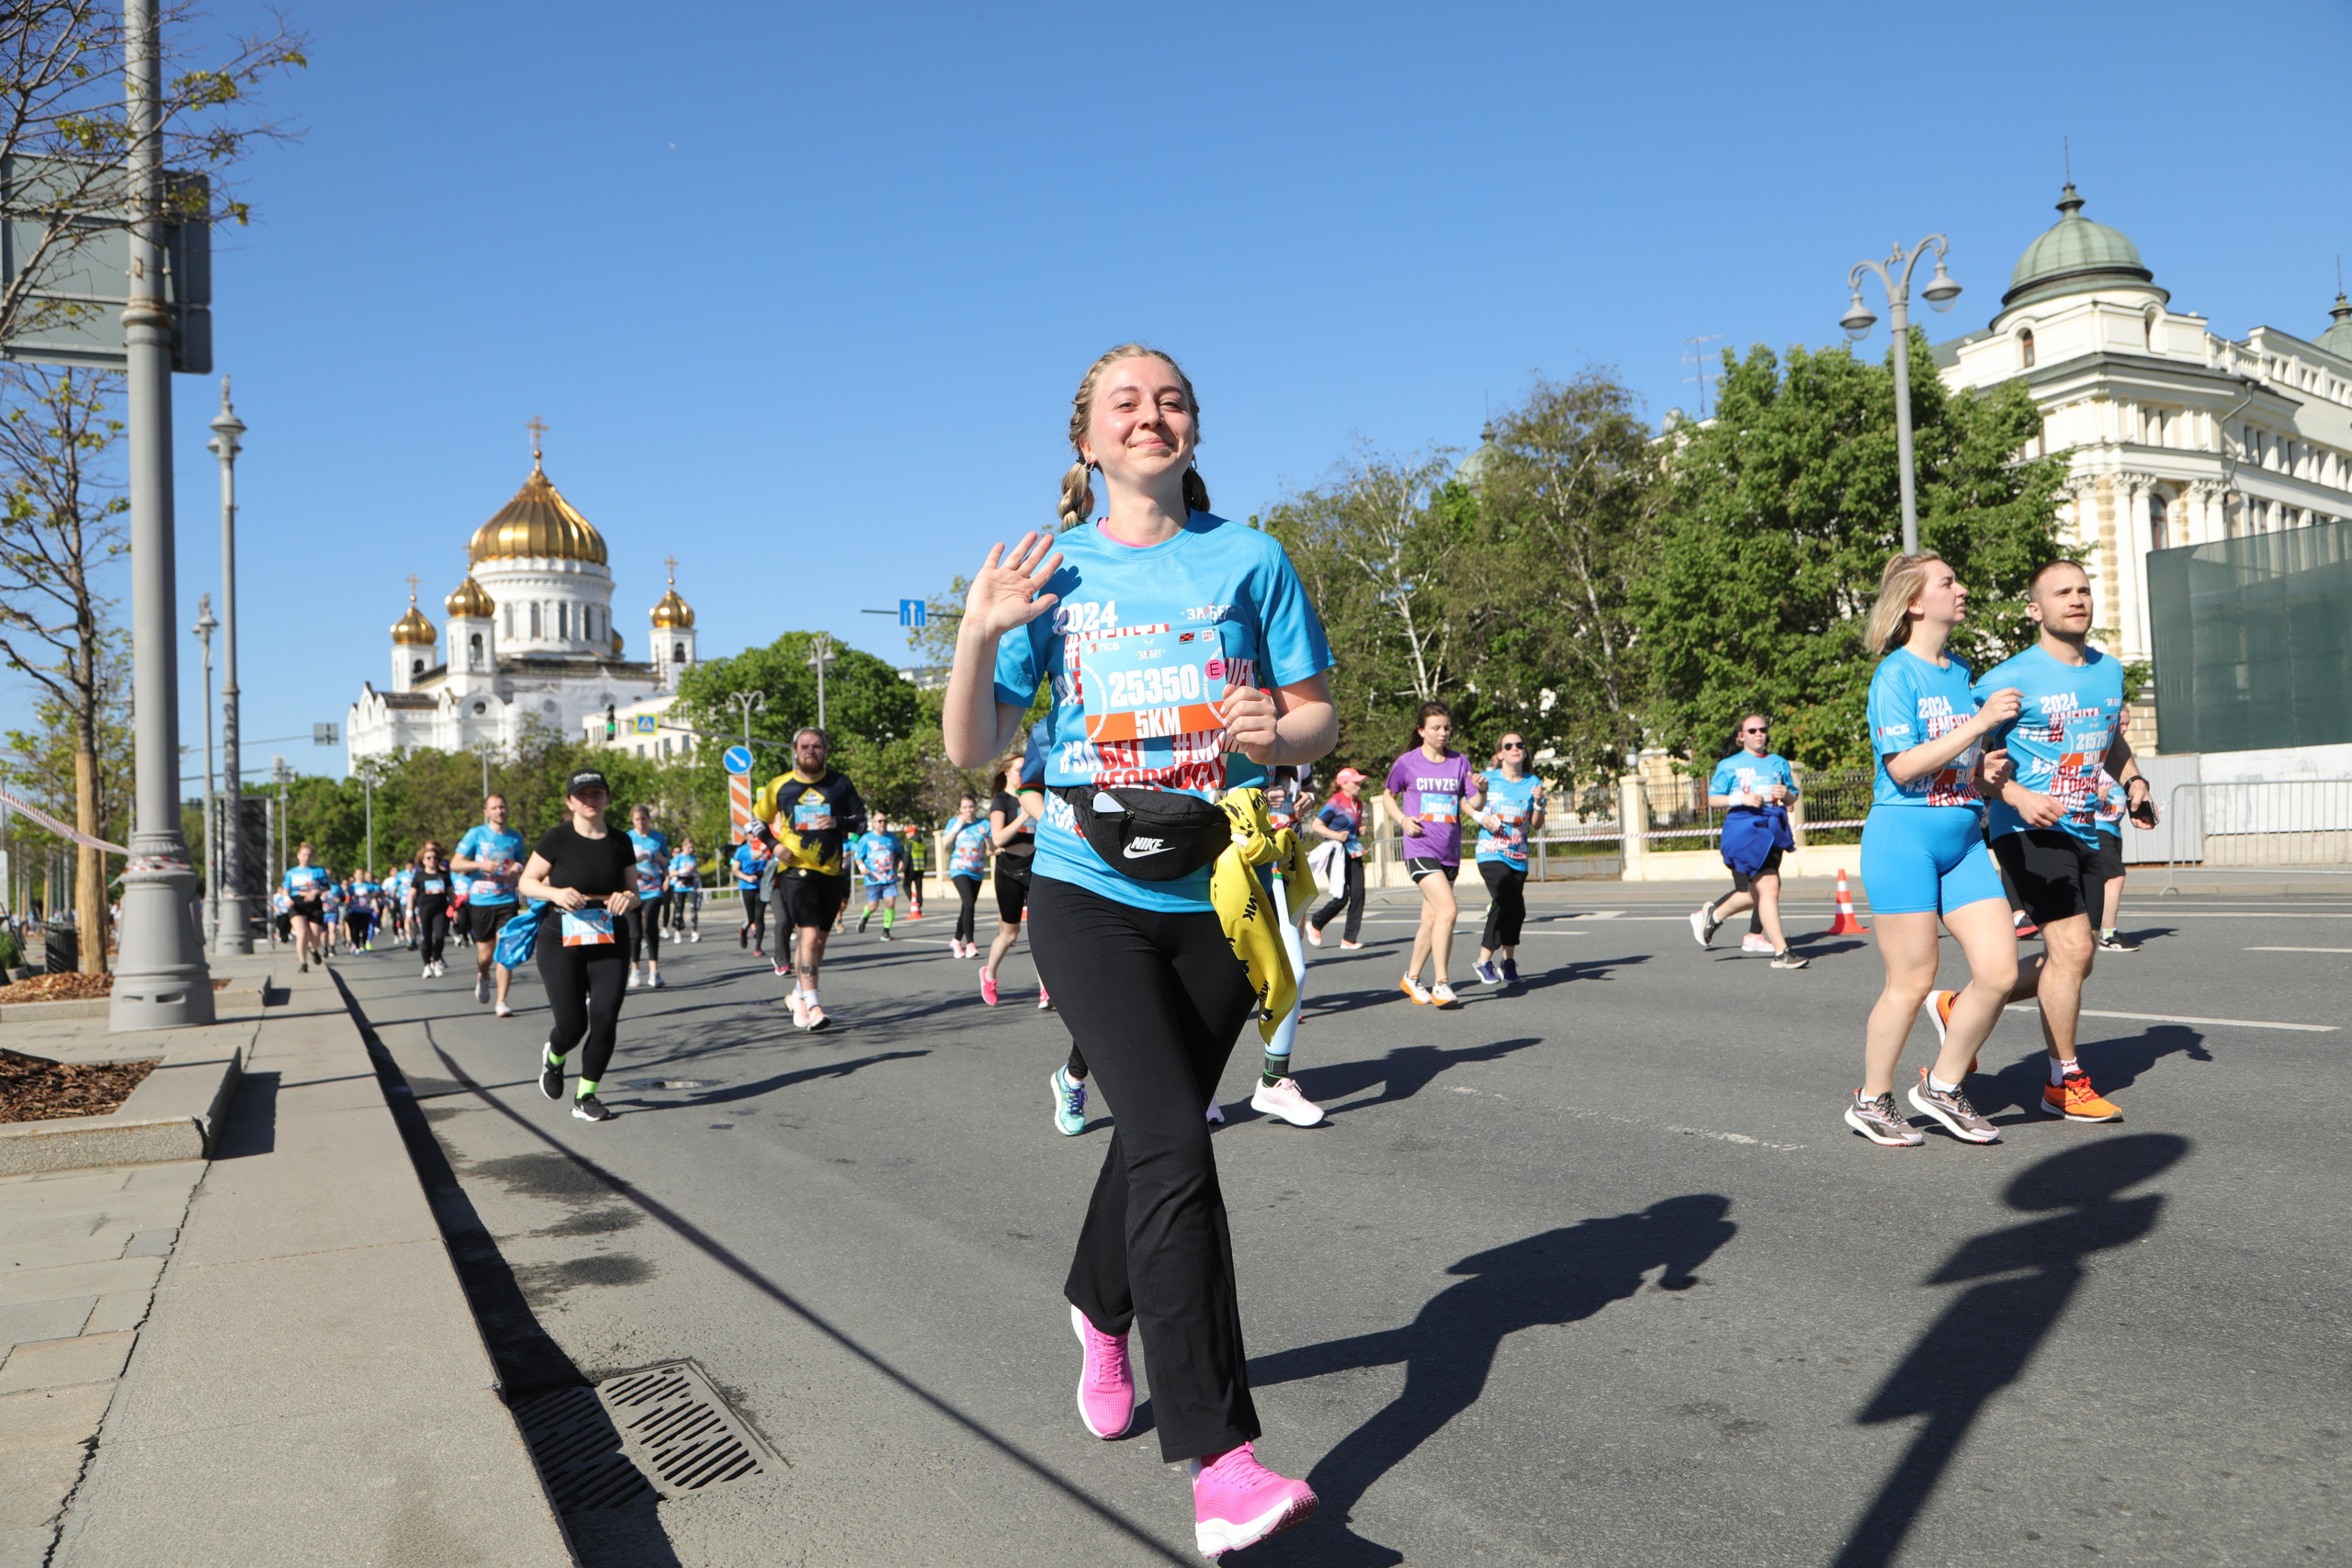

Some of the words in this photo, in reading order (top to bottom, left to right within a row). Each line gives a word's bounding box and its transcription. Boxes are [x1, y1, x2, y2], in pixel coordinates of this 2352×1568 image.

[1052, 600, 1118, 636] 2024
[1099, 641, 1120, 652] ПСБ
[1108, 663, 1200, 707] 25350
[1917, 695, 1953, 719] 2024
[2040, 692, 2079, 714] 2024
[1135, 705, 1182, 739] 5KM
[1885, 724, 1910, 736] ПСБ
[2076, 730, 2108, 751] 21575
[2083, 750, 2101, 766] 5KM
[1131, 837, 1164, 851] NIKE
